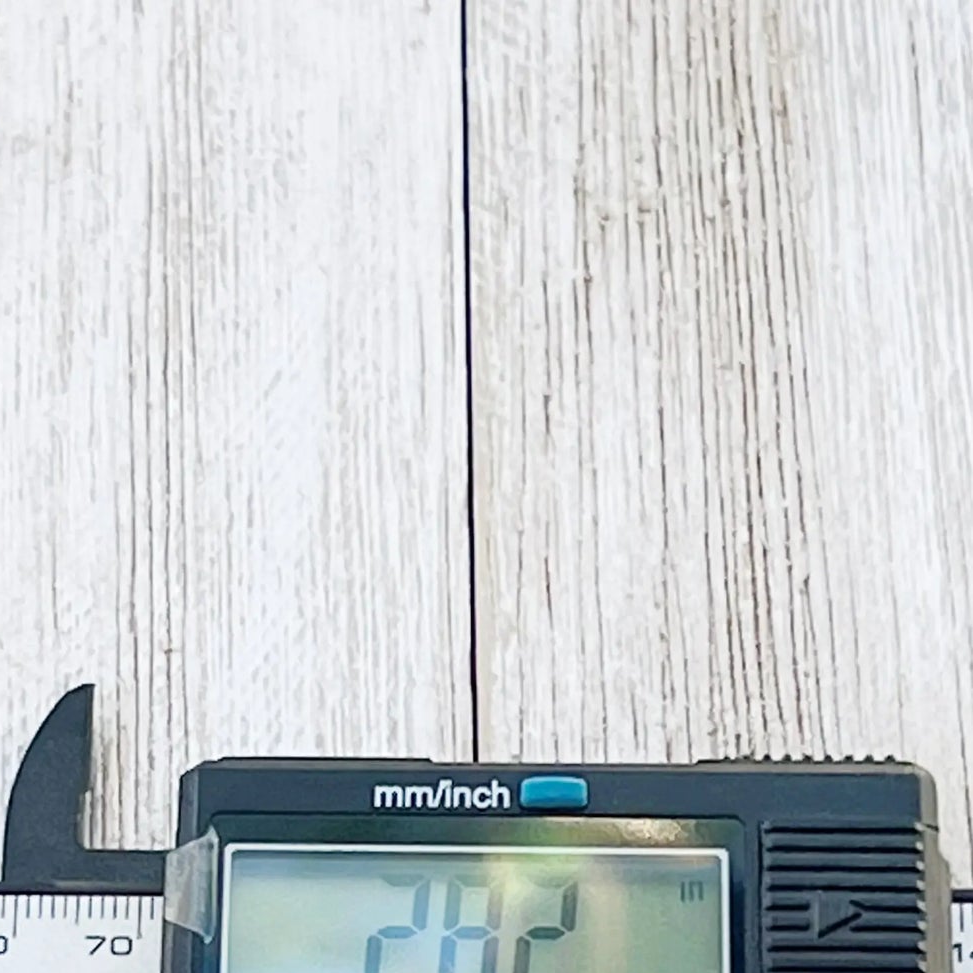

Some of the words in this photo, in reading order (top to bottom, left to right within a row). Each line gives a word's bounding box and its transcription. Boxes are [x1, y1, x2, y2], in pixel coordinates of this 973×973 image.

[373, 779, 511, 809] mm/inch
[84, 936, 133, 955] 70
[953, 943, 973, 963] 1
